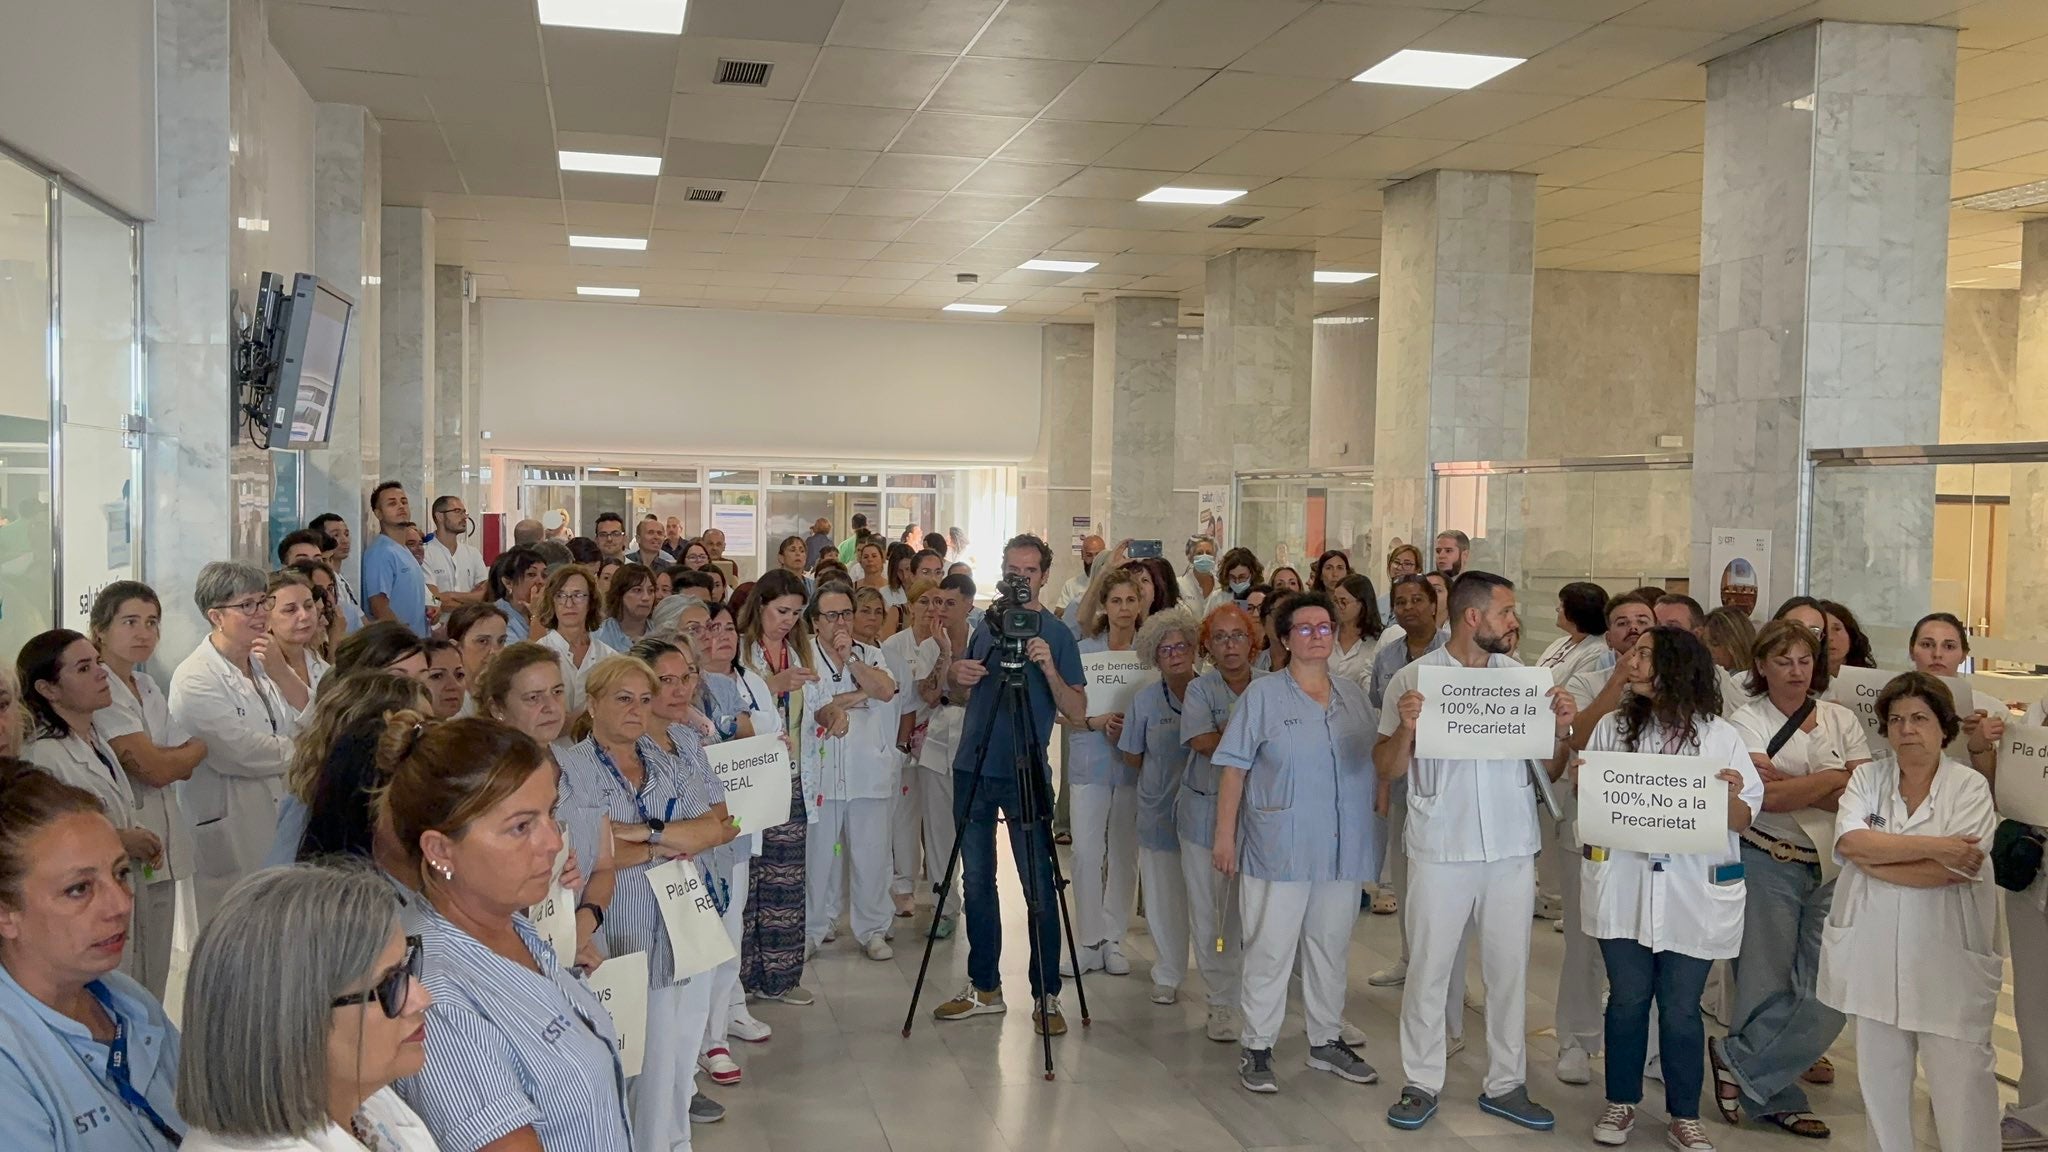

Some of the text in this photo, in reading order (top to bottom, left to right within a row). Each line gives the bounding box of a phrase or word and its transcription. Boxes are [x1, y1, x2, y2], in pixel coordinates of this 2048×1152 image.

[1091, 662, 1105, 672] de
[1096, 674, 1128, 685] REAL
[1441, 684, 1538, 697] Contractes al
[1440, 702, 1537, 716] 100%,No a la
[1447, 721, 1527, 735] Precarietat
[2012, 741, 2048, 758] Pla d
[714, 752, 780, 775] de benestar
[722, 775, 754, 792] REAL
[1603, 769, 1706, 789] Contractes al
[1602, 790, 1706, 810] 100%,No a la
[1611, 811, 1697, 830] Precarietat
[666, 882, 684, 900] Pla
[694, 893, 714, 913] RE
